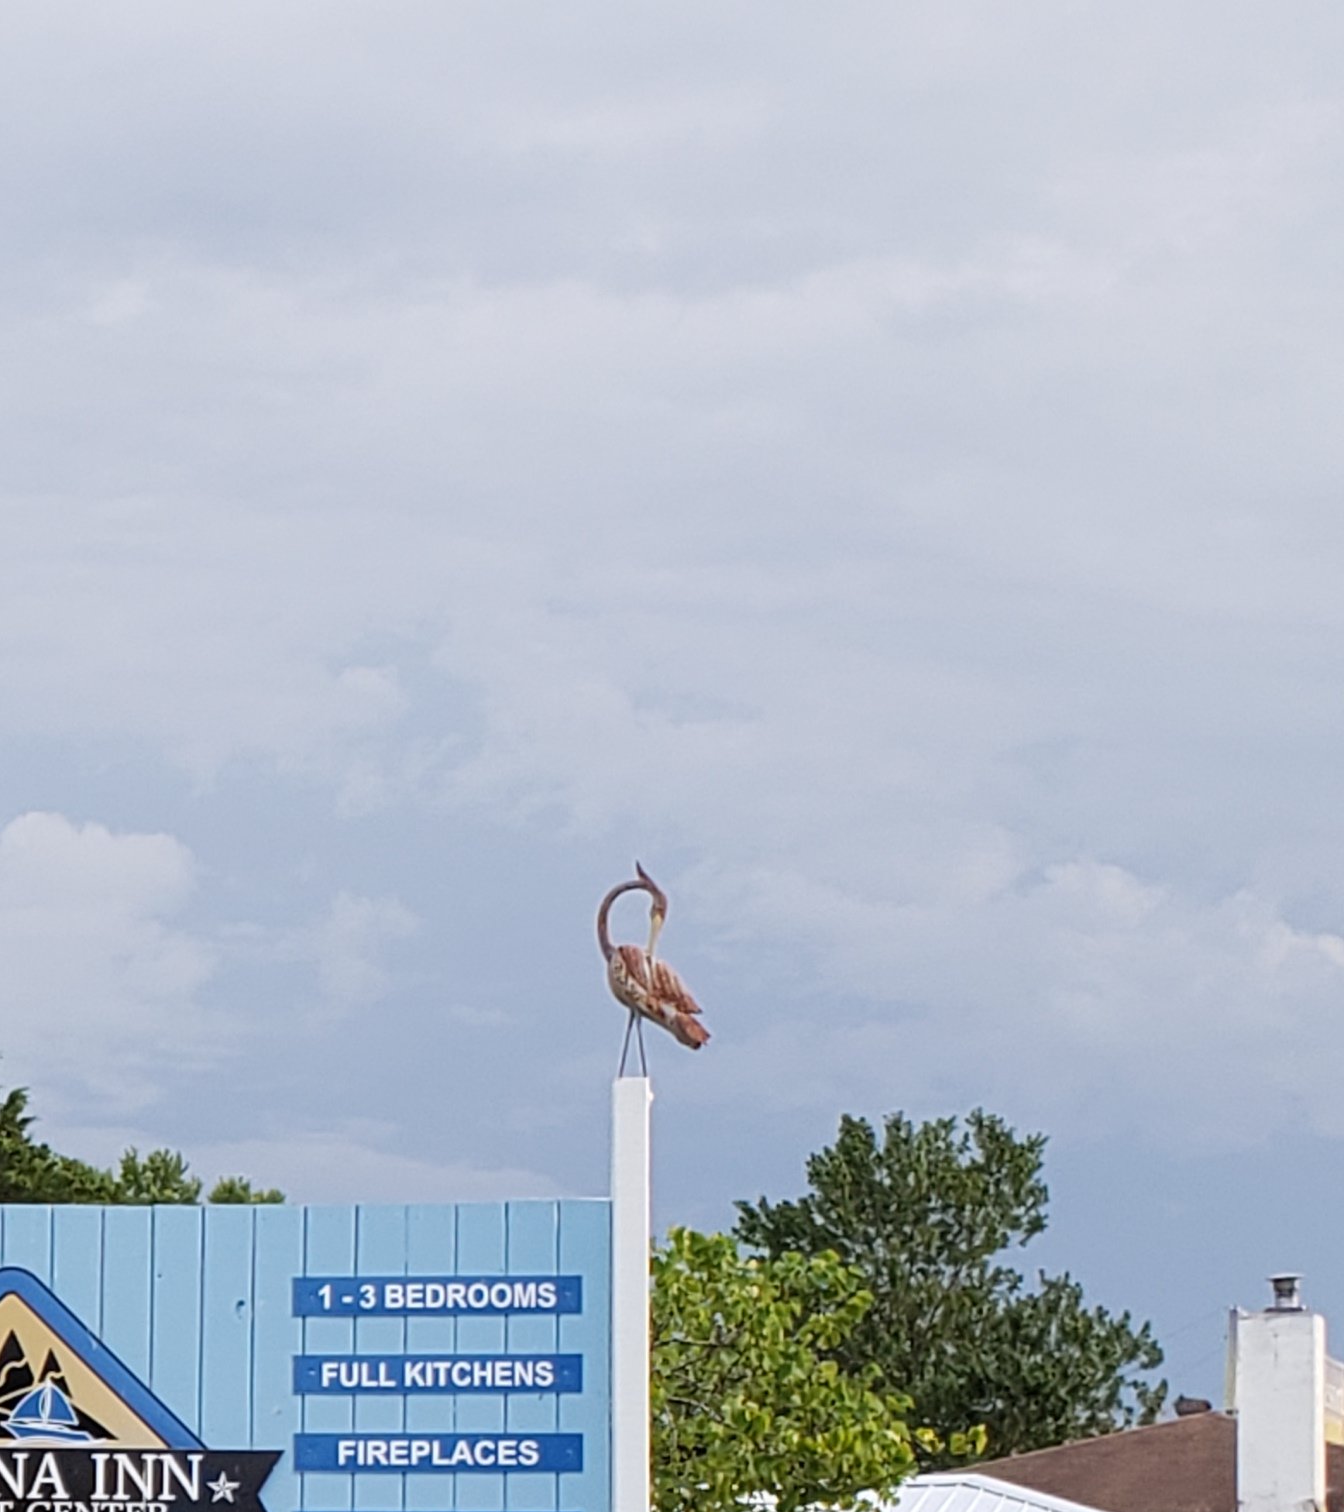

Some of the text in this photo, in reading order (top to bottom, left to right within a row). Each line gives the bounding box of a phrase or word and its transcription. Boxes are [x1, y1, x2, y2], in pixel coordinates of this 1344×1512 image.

[318, 1284, 331, 1309] 1
[359, 1284, 376, 1308] 3
[384, 1283, 557, 1308] BEDROOMS
[321, 1361, 554, 1387] FULL KITCHENS
[337, 1440, 540, 1466] FIREPLACES
[90, 1453, 204, 1501] INN
